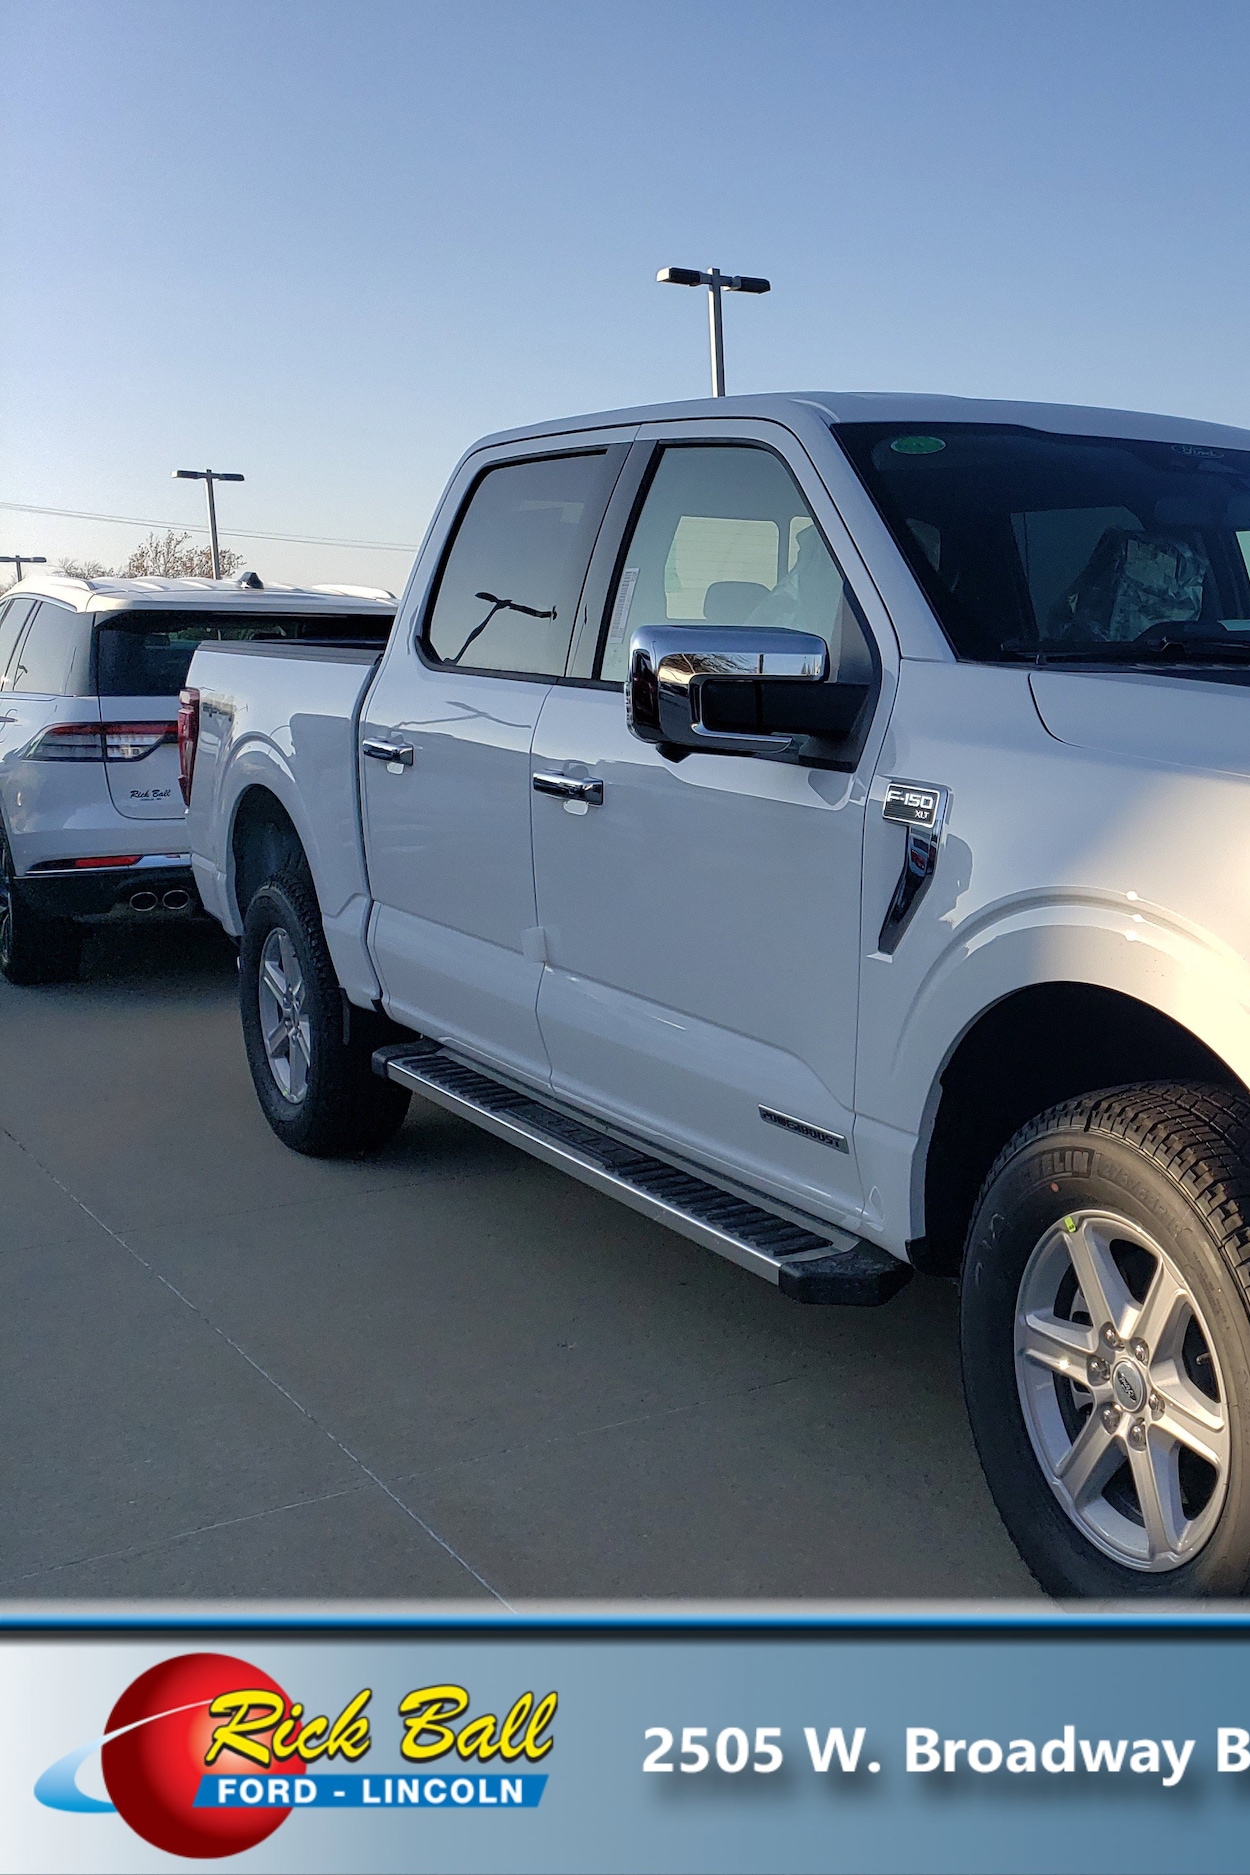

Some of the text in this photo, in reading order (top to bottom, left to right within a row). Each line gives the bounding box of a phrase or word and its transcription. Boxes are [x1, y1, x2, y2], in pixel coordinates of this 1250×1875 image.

[130, 790, 150, 799] Rick
[152, 789, 171, 798] Ball
[886, 790, 934, 810] F-150
[914, 809, 930, 820] XLT
